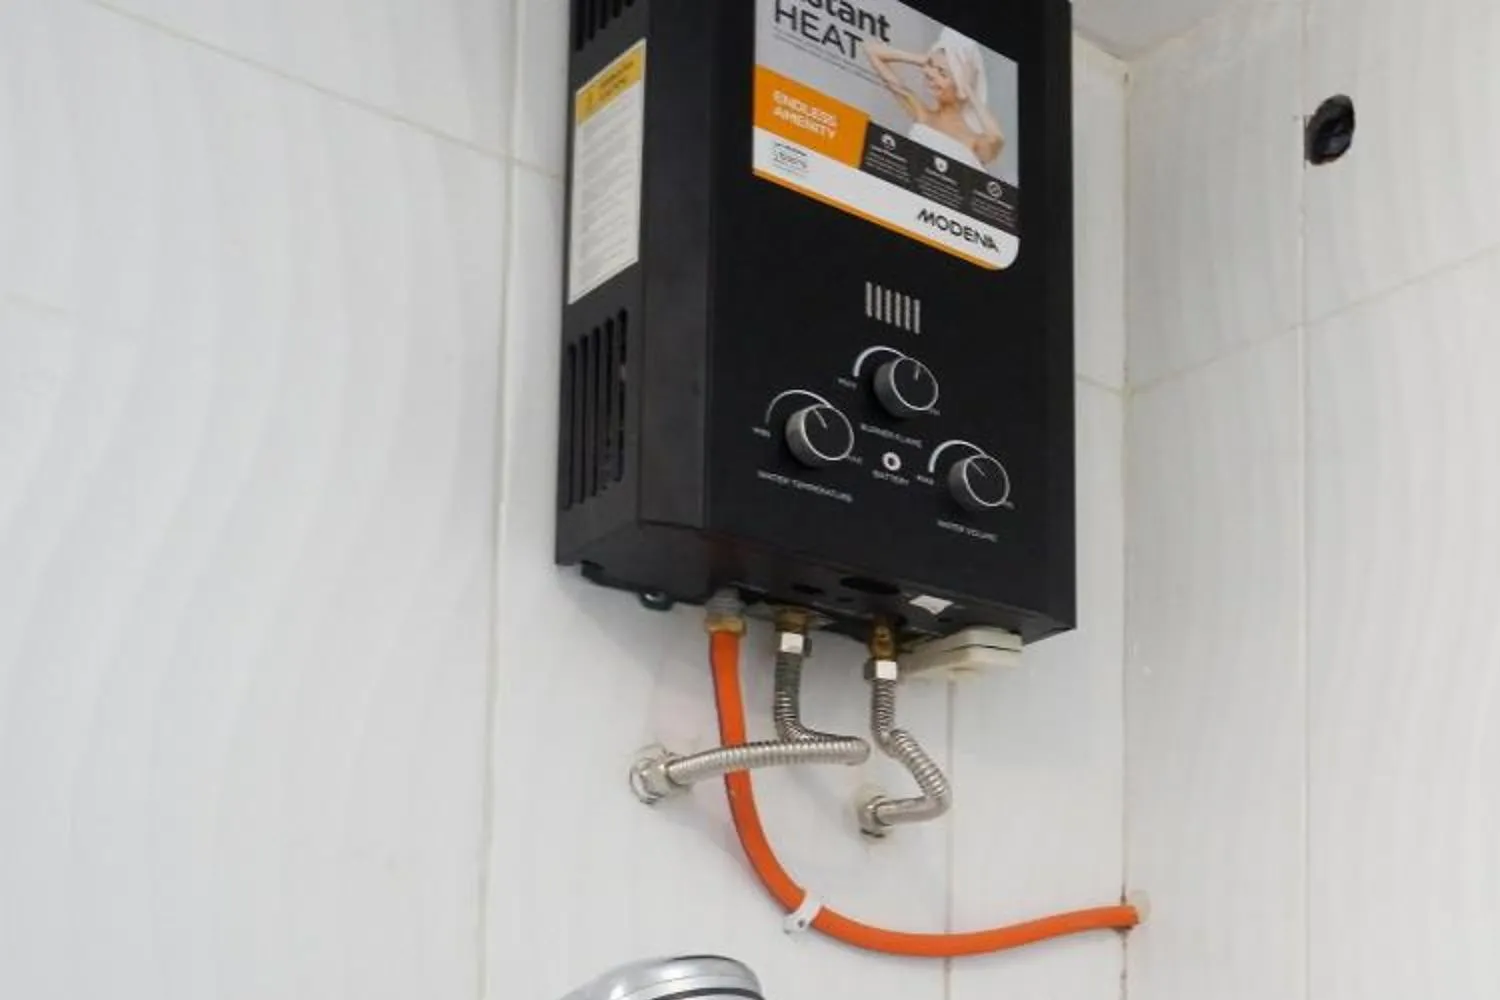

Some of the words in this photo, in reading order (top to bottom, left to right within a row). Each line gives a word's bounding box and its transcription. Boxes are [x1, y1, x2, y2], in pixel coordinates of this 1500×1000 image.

[775, 0, 864, 59] HEAT
[773, 89, 837, 129] ENDLESS
[773, 106, 837, 139] AMENITY
[917, 208, 1000, 253] MODENA
